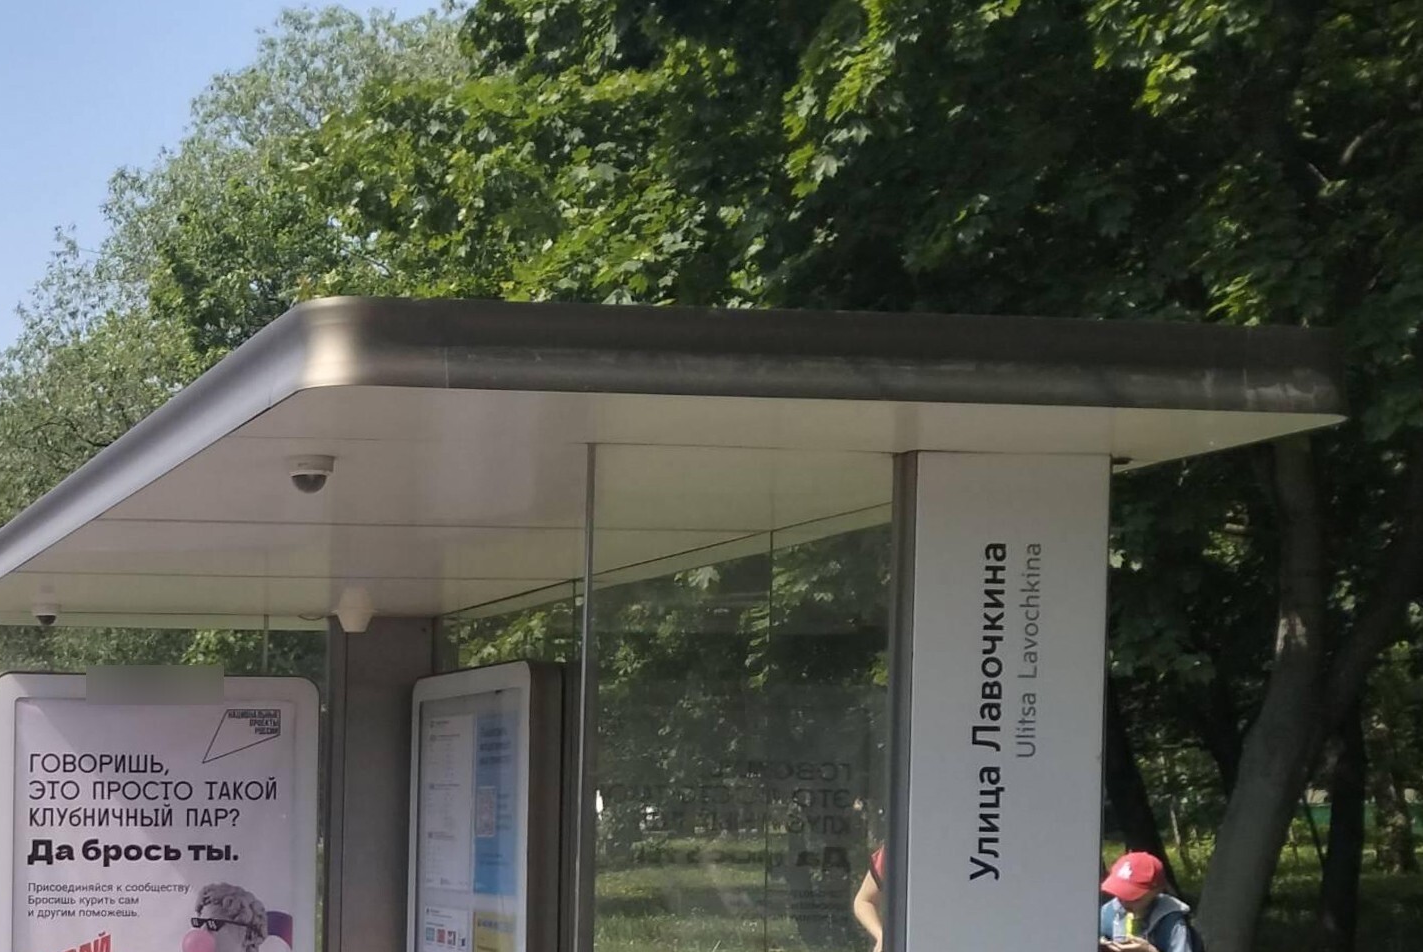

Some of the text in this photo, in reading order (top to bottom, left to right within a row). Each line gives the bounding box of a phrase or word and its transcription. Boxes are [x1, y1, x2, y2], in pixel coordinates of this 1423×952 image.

[1016, 543, 1042, 758] Ulitsa Lavochkina
[969, 543, 1006, 881] Улица Лавочкина
[30, 753, 169, 776] ГОВОРИШЬ,
[29, 776, 277, 800] ЭТО ПРОСТО ТАКОЙ
[186, 808, 240, 827] ПАР?
[27, 838, 239, 867] Да брось ты.
[28, 882, 190, 895] Присоединяйся к сообществу
[28, 895, 139, 907] Бросишь курить сам
[28, 909, 34, 917] и
[37, 909, 76, 920] другим
